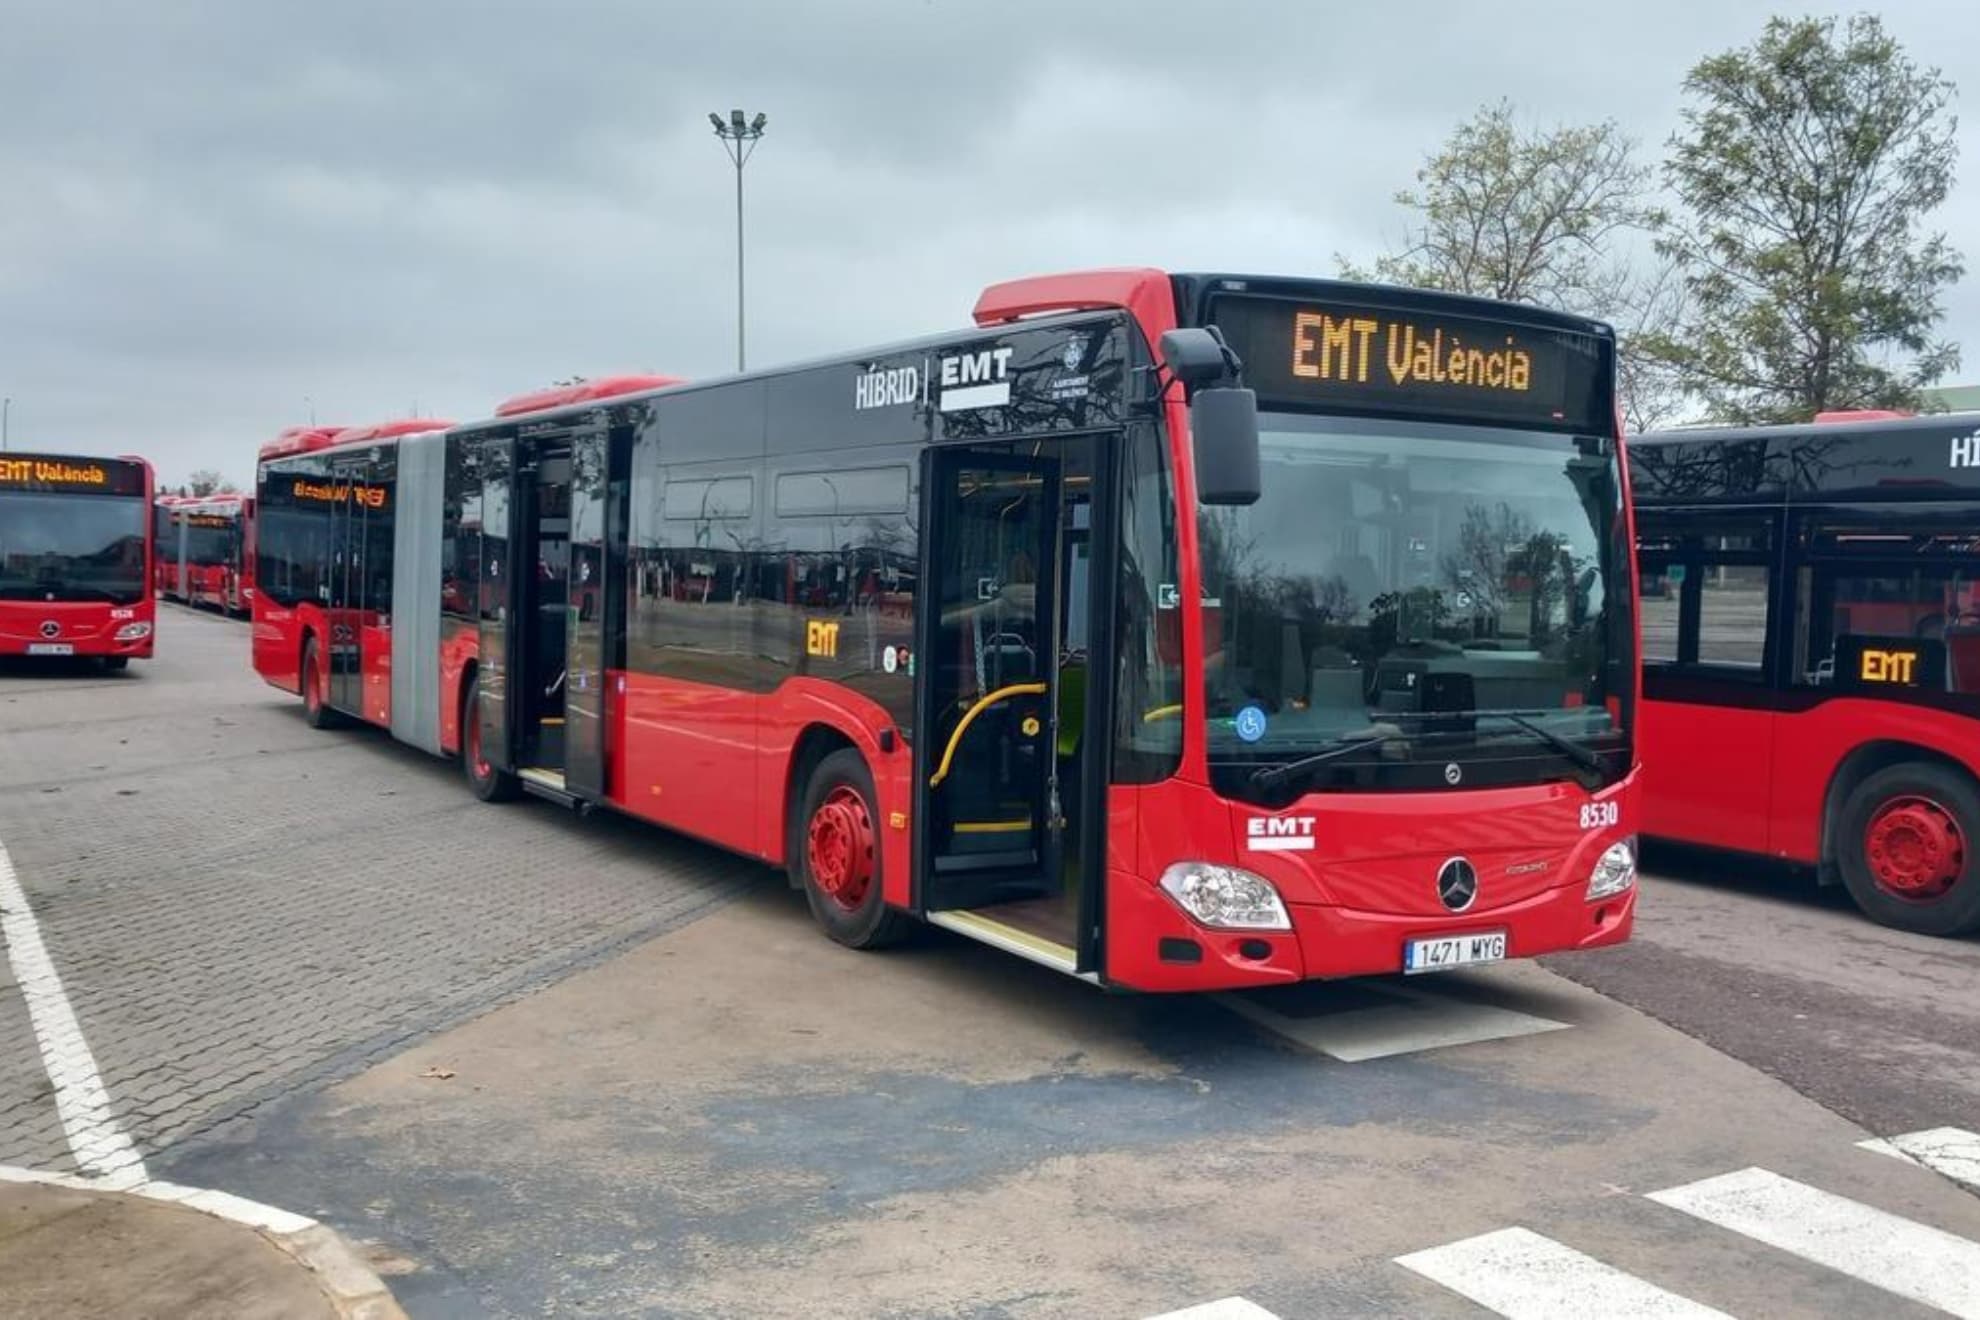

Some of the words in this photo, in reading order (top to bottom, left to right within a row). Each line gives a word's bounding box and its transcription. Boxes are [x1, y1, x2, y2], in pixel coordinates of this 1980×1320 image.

[941, 348, 1013, 386] EMT
[1293, 312, 1378, 383] EMT
[1387, 324, 1531, 391] València
[856, 362, 918, 410] HÍBRID
[807, 620, 839, 657] EMT
[1862, 650, 1917, 683] EMT
[1247, 816, 1317, 836] EMT
[1580, 801, 1618, 829] 8530
[1421, 942, 1462, 966] 1471
[1470, 937, 1504, 960] MYG
